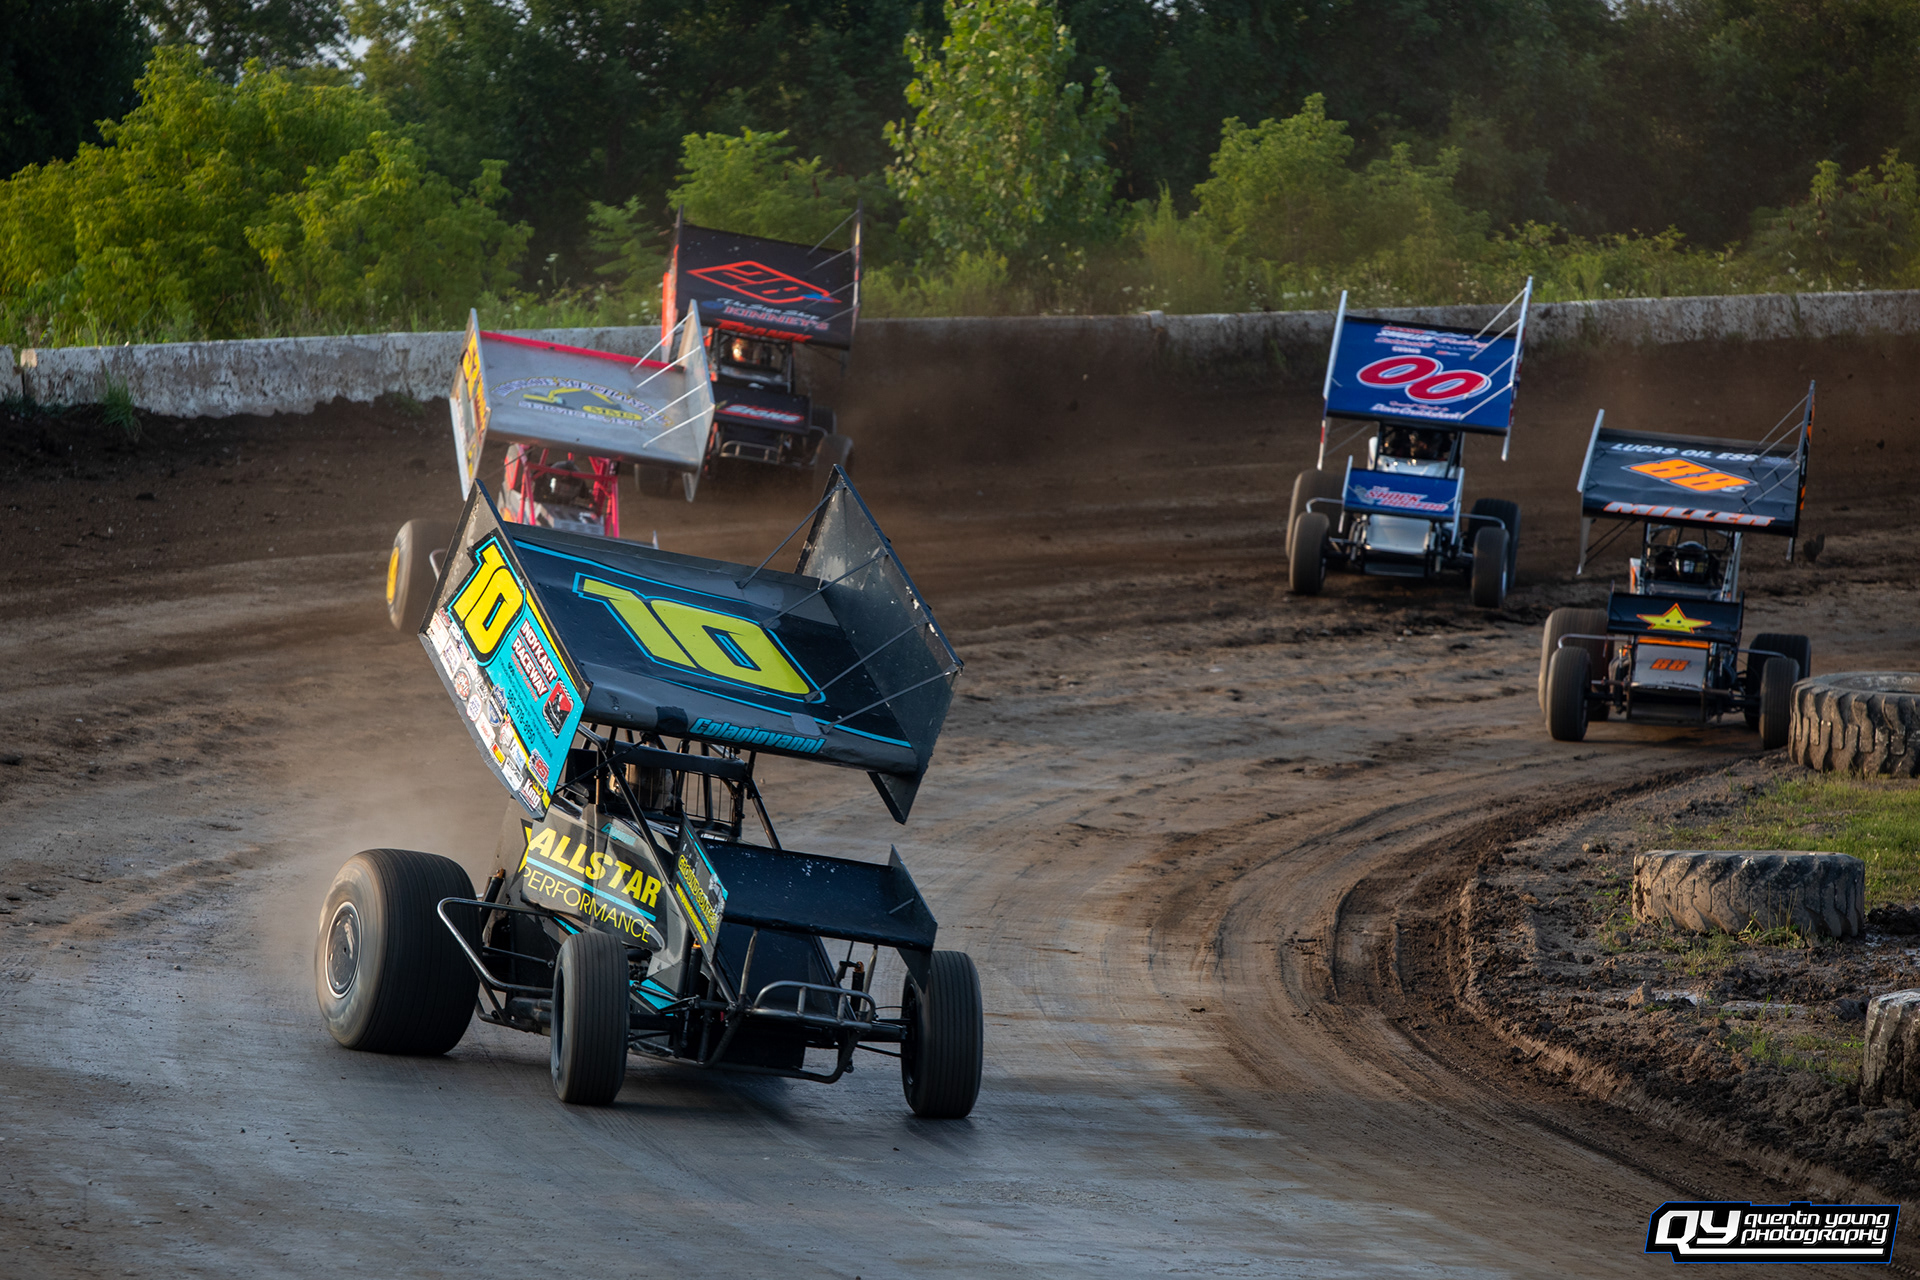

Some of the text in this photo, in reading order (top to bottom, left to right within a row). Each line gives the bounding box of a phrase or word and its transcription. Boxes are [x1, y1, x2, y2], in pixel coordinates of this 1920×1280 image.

[717, 297, 821, 321] The Sign Shop
[1357, 355, 1491, 404] 00
[1610, 443, 1678, 455] LUCAS
[1681, 449, 1712, 458] OIL
[1716, 452, 1759, 462] ESS
[1629, 459, 1751, 492] 88
[1365, 490, 1427, 502] SHOCK
[1603, 501, 1776, 527] MILLER
[453, 543, 523, 654] 10
[520, 618, 558, 684] INDYKART
[583, 578, 810, 695] 10
[511, 635, 549, 698] RACEWAY
[1651, 658, 1690, 671] 88
[689, 717, 826, 755] Colagiovanni
[523, 778, 541, 808] King
[528, 827, 662, 908] ALLSTAR
[678, 854, 700, 896] GROUND
